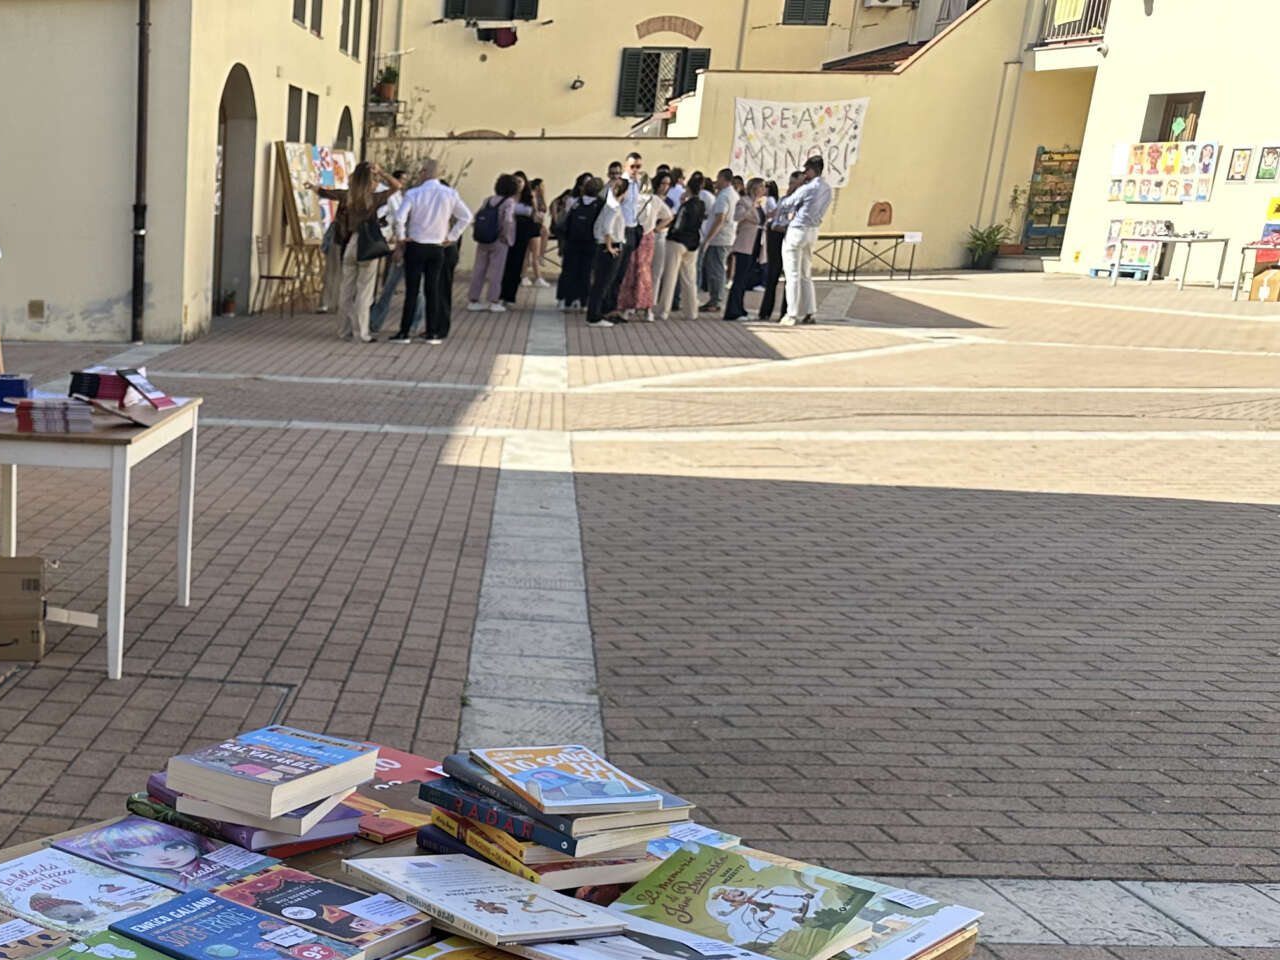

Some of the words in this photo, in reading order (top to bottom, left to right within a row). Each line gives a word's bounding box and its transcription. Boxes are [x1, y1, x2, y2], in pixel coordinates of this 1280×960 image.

[742, 106, 816, 130] AREA
[453, 798, 535, 840] RADAR
[130, 914, 173, 933] ENRICO
[170, 896, 218, 919] GALIANO
